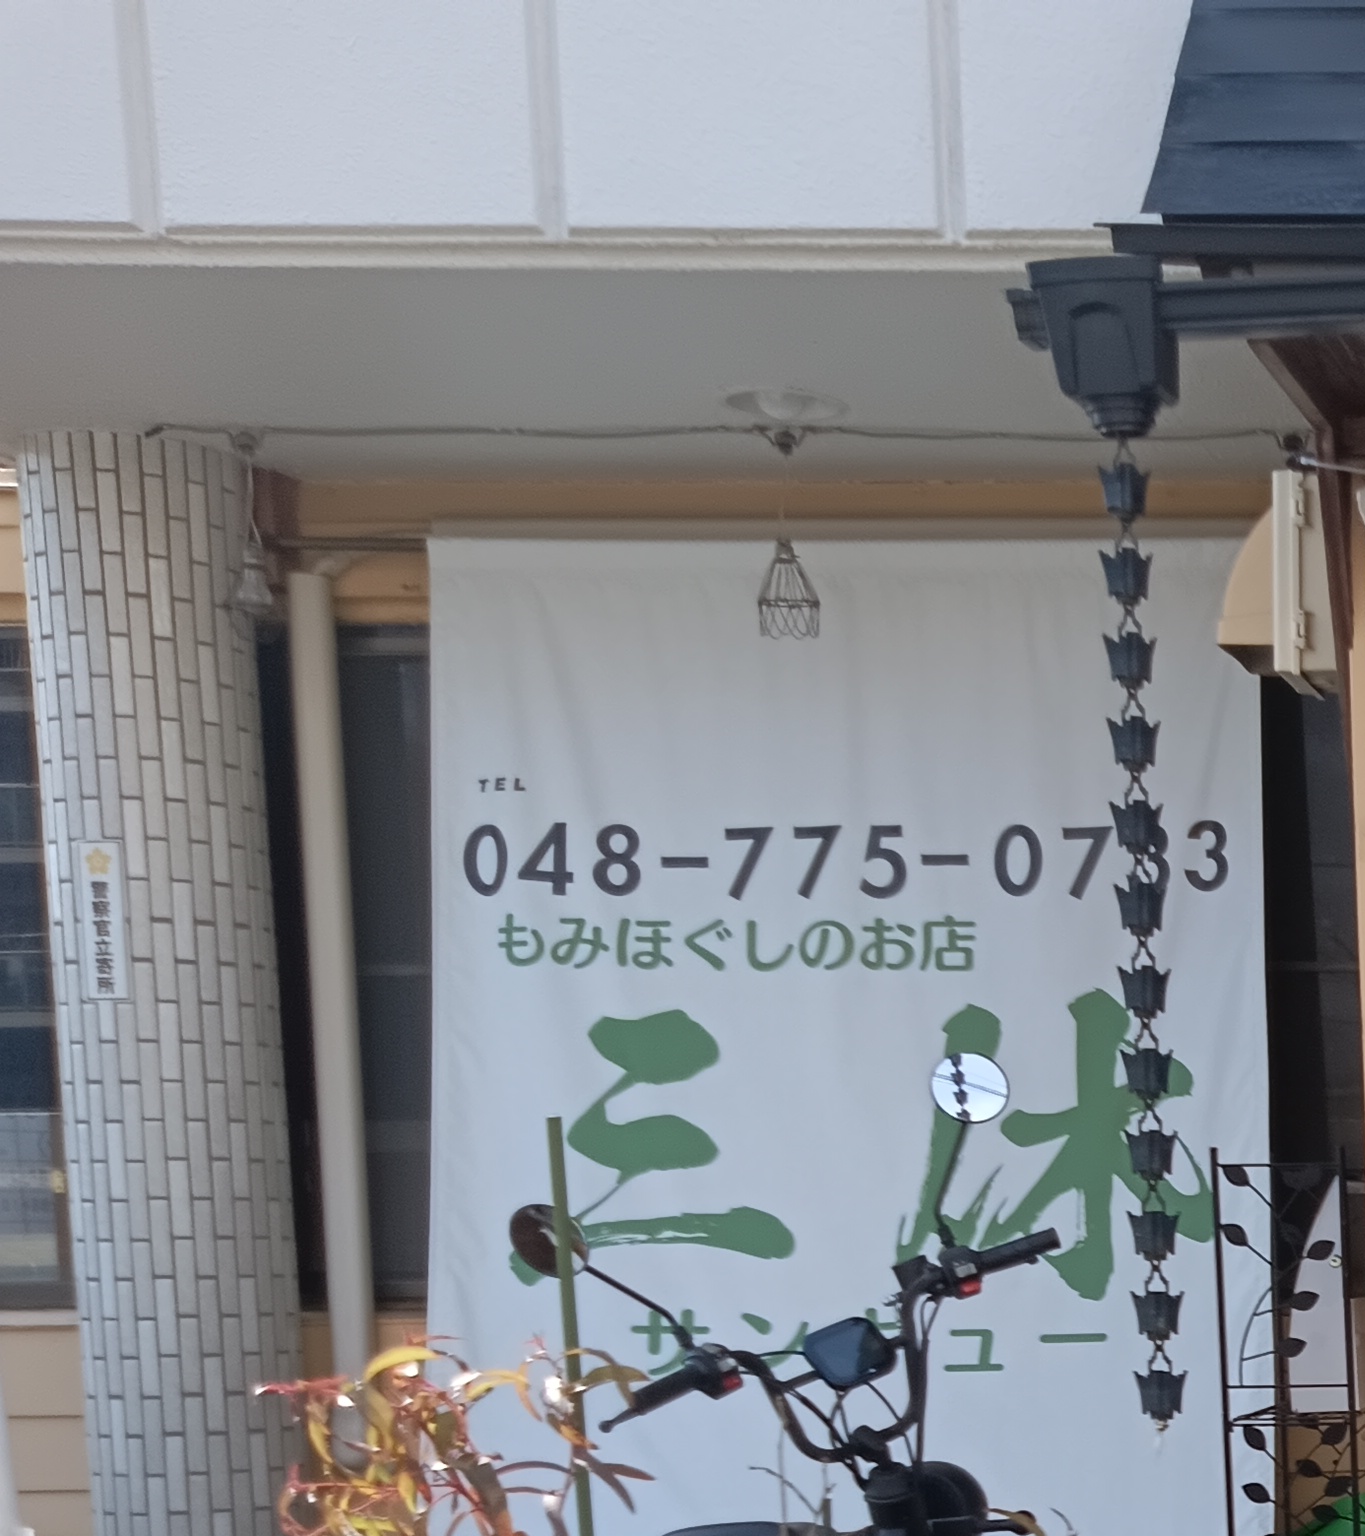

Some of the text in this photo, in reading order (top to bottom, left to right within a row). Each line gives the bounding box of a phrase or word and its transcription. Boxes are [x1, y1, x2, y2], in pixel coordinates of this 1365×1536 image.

[477, 777, 527, 793] TEL
[497, 912, 978, 973] もみほぐしのお店
[508, 986, 1217, 1302] 三休
